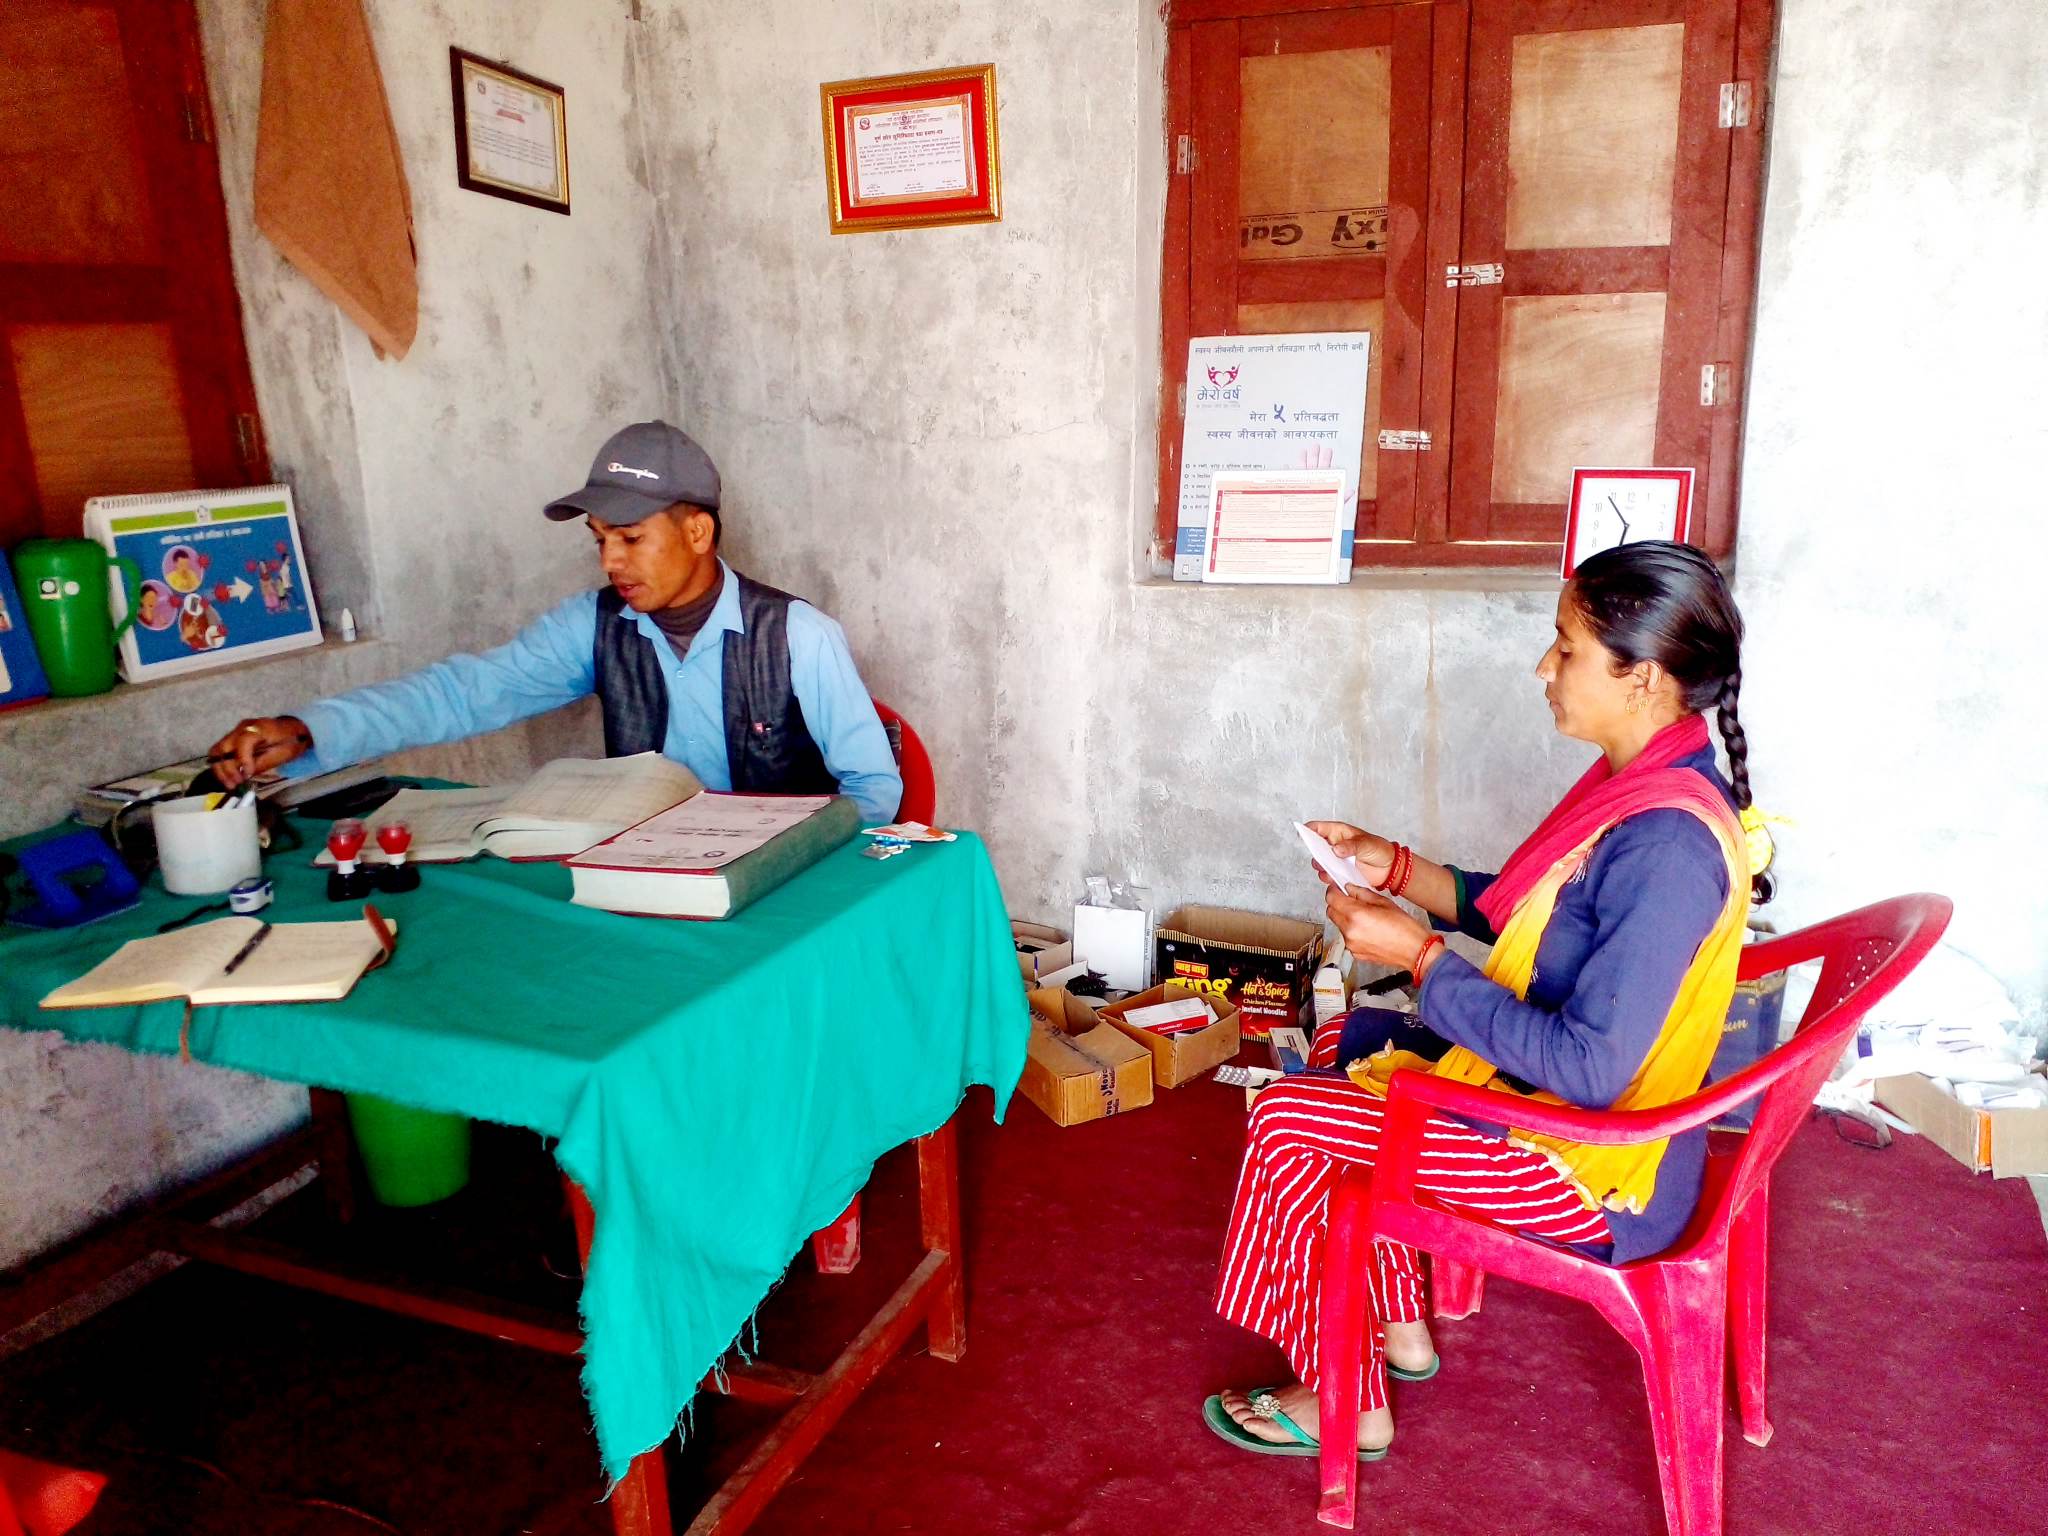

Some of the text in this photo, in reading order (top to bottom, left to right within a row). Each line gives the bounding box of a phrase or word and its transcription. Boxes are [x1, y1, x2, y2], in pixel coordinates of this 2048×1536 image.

[1197, 385, 1242, 401] मेरो वर्ष
[1249, 410, 1267, 422] मेरा
[1273, 403, 1286, 423] ५
[1206, 428, 1339, 440] स्वस्थ जीवनको आवश्यकता
[1240, 981, 1260, 996] Hot
[1264, 981, 1290, 1000] Spicy
[1241, 1005, 1288, 1017] Instant Noodles
